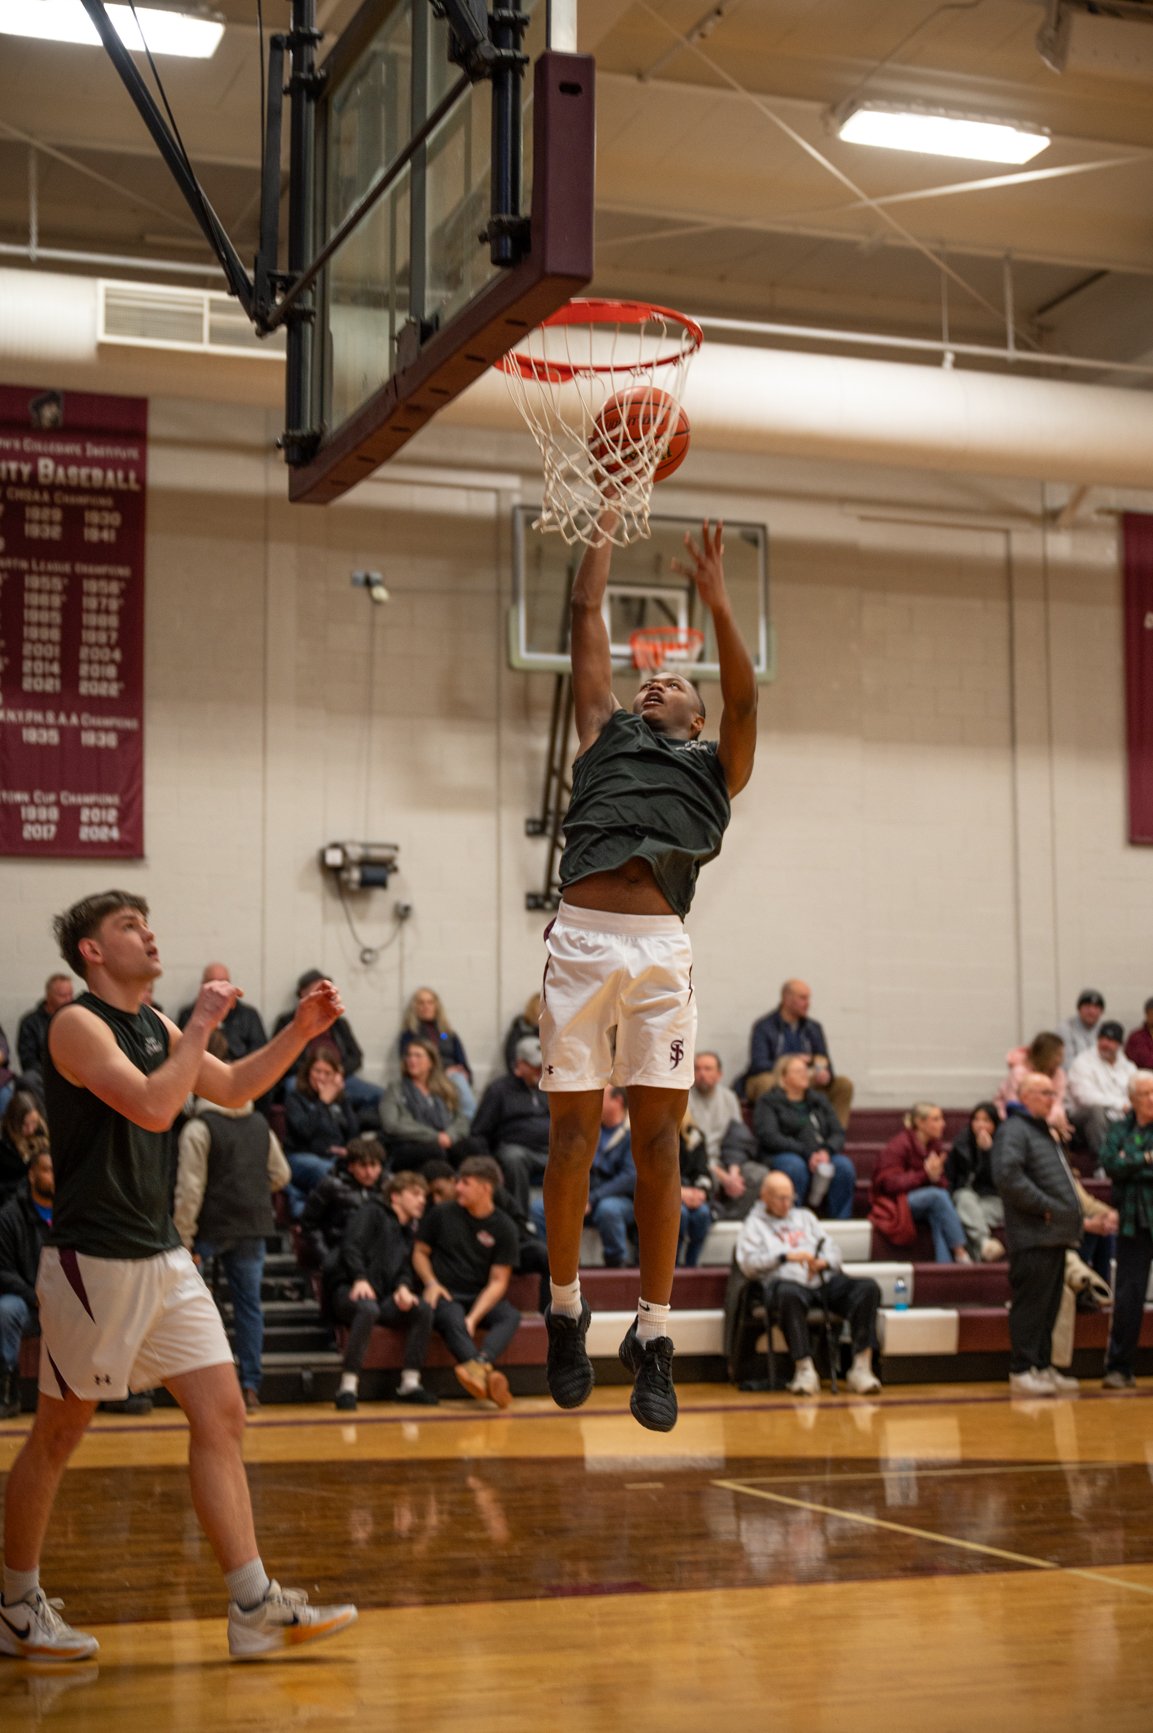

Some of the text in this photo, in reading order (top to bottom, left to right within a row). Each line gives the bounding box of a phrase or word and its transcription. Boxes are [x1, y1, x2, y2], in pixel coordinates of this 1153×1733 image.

[37, 456, 141, 491] BASEBALL
[22, 641, 121, 664] 2001 2004
[22, 658, 60, 675] 2014
[22, 822, 57, 840] 2017
